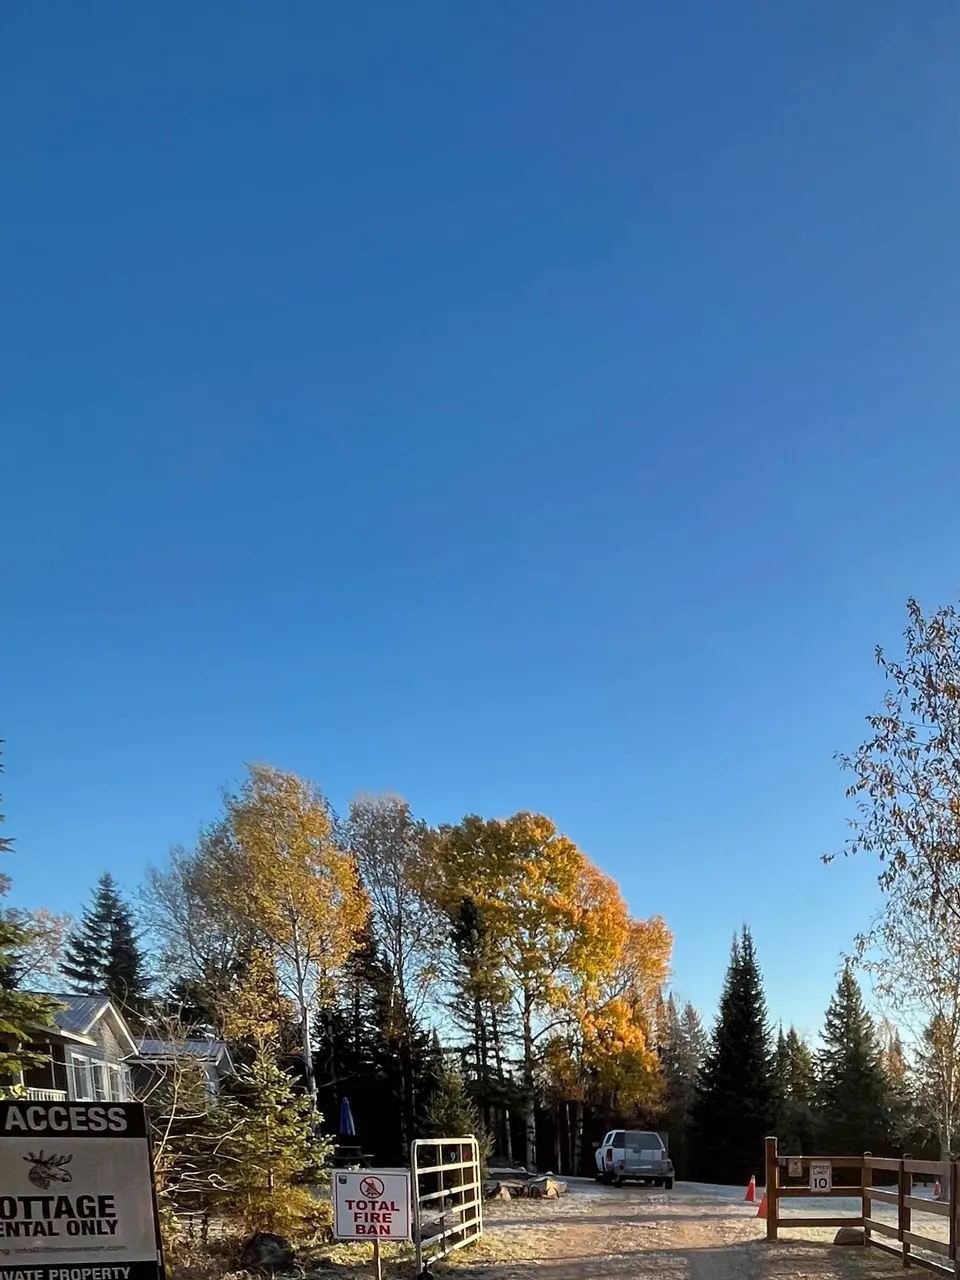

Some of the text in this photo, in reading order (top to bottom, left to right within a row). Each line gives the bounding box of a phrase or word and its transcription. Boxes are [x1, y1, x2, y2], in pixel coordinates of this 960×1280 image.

[5, 1106, 128, 1131] ACCESS
[813, 1178, 828, 1189] 10
[345, 1200, 400, 1212] TOTAL
[353, 1212, 392, 1223] FIRE
[66, 1219, 118, 1236] ONLY
[355, 1224, 391, 1235] BAN
